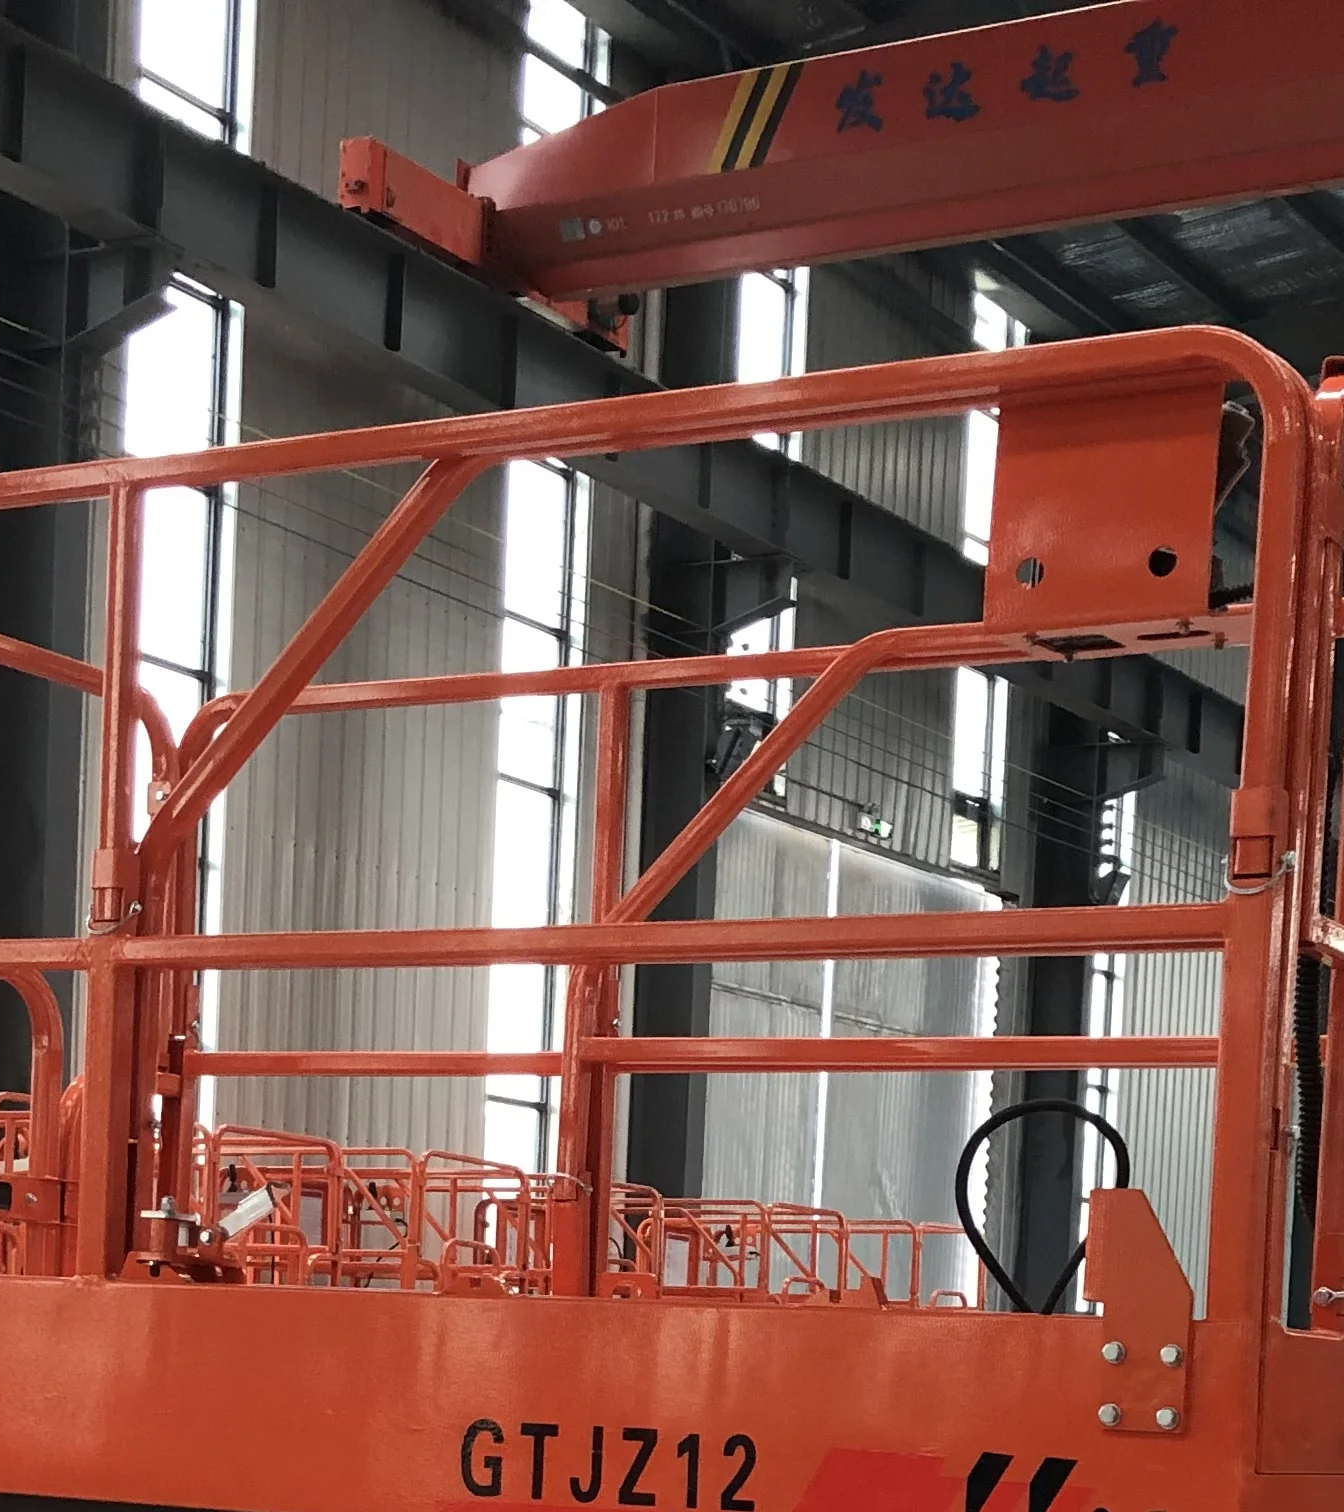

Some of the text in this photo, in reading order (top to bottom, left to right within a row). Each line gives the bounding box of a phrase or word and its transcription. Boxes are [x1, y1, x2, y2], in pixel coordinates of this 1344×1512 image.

[836, 20, 1179, 133] 发达起重
[460, 1418, 757, 1512] GTJZ12
